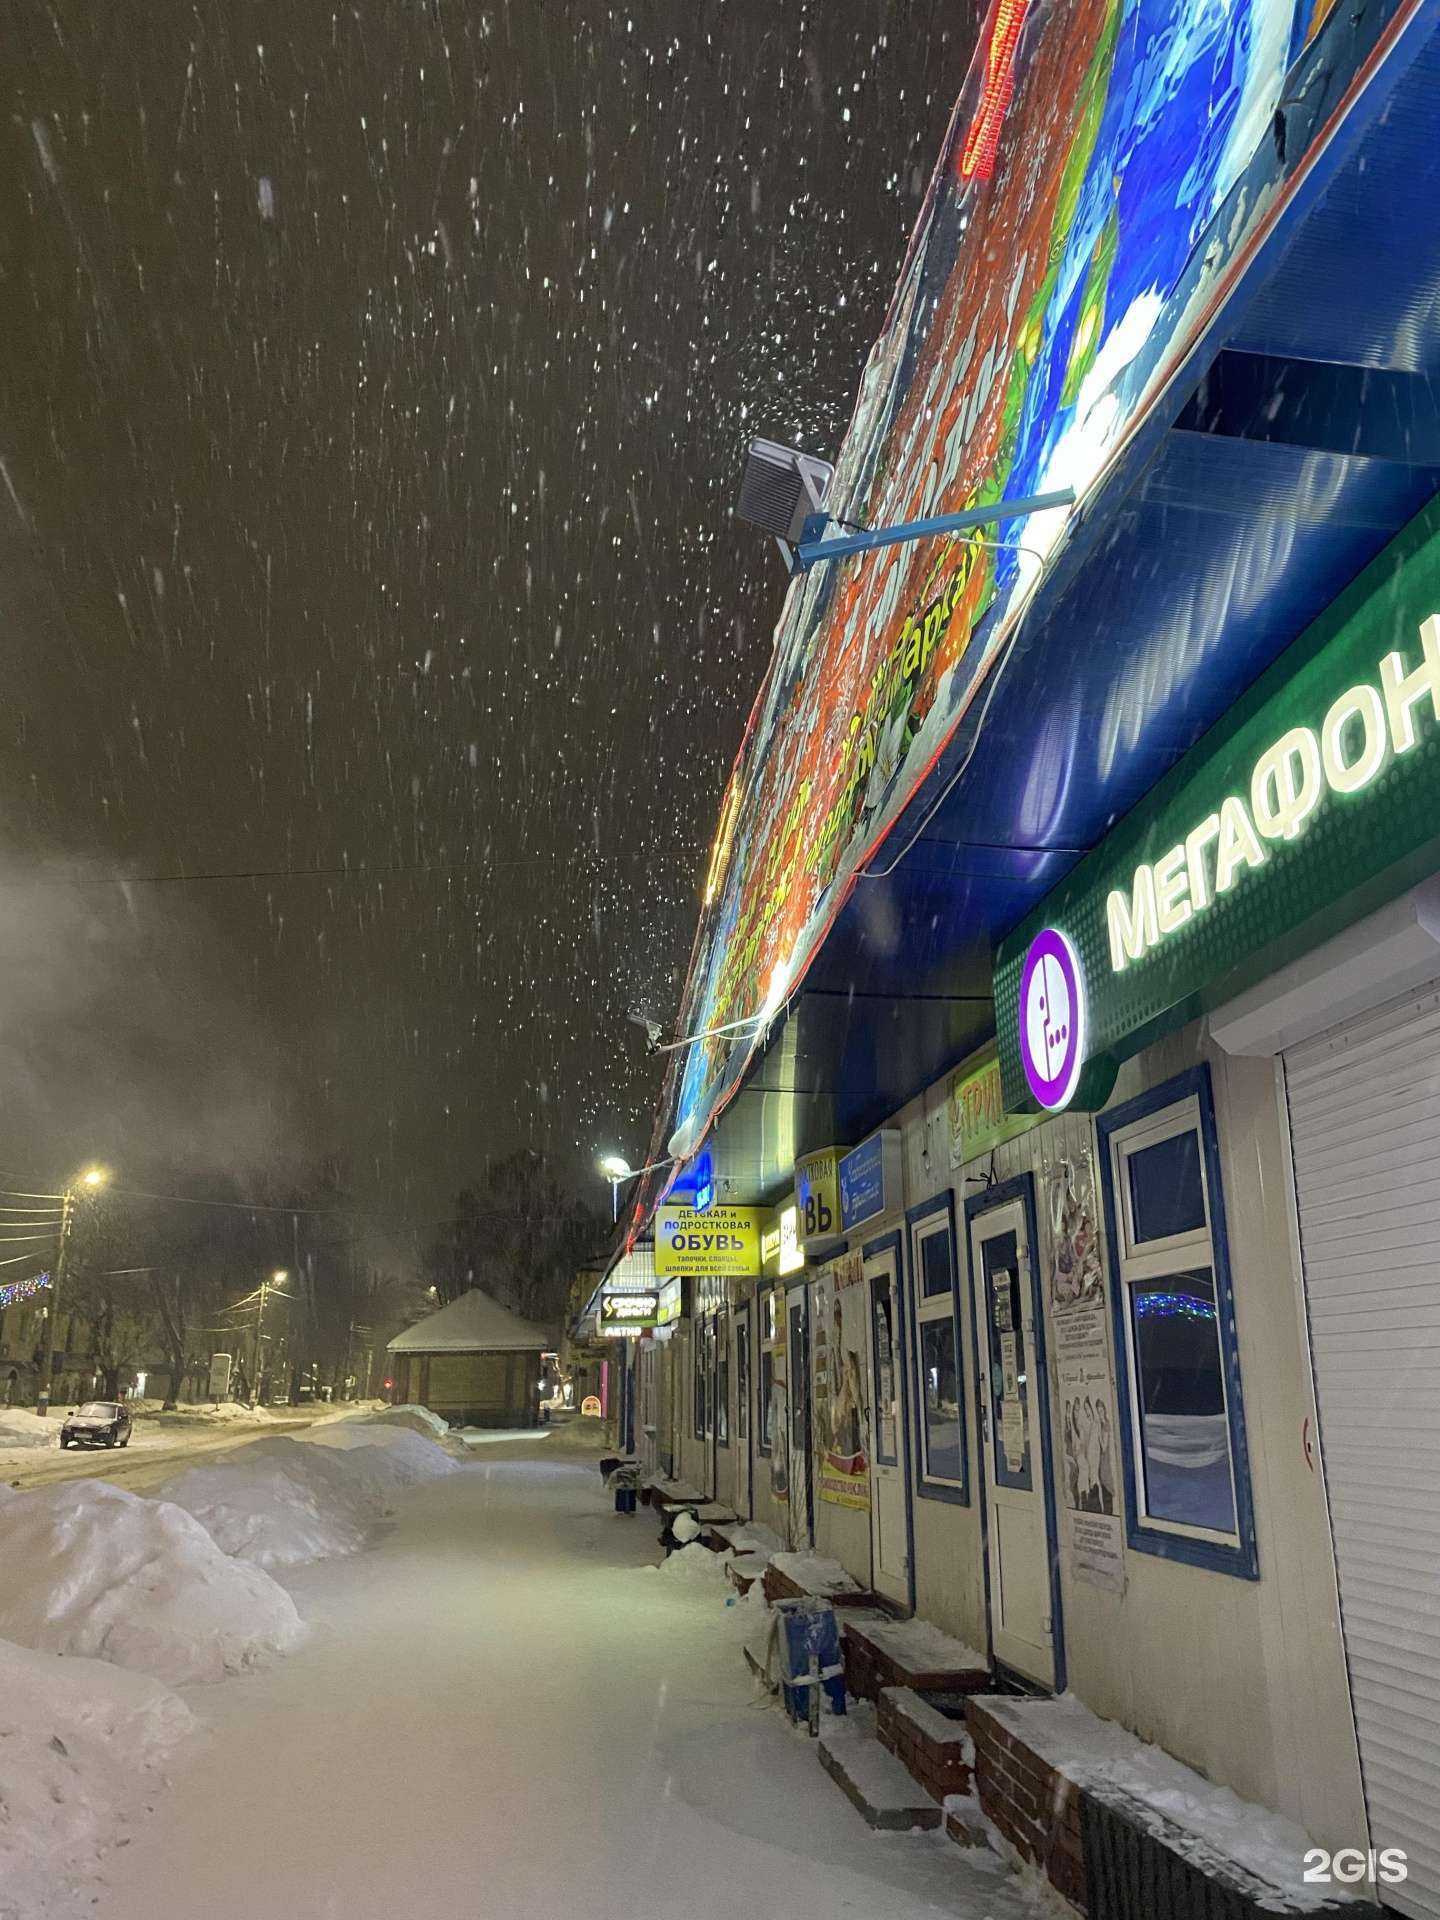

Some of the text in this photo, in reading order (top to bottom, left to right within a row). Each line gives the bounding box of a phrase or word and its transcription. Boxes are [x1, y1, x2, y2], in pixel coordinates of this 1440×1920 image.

[1105, 613, 1440, 973] МЕГАФОН
[664, 1221, 751, 1231] ПОДРОСТКОВАЯ
[671, 1234, 744, 1251] ОБУВЬ
